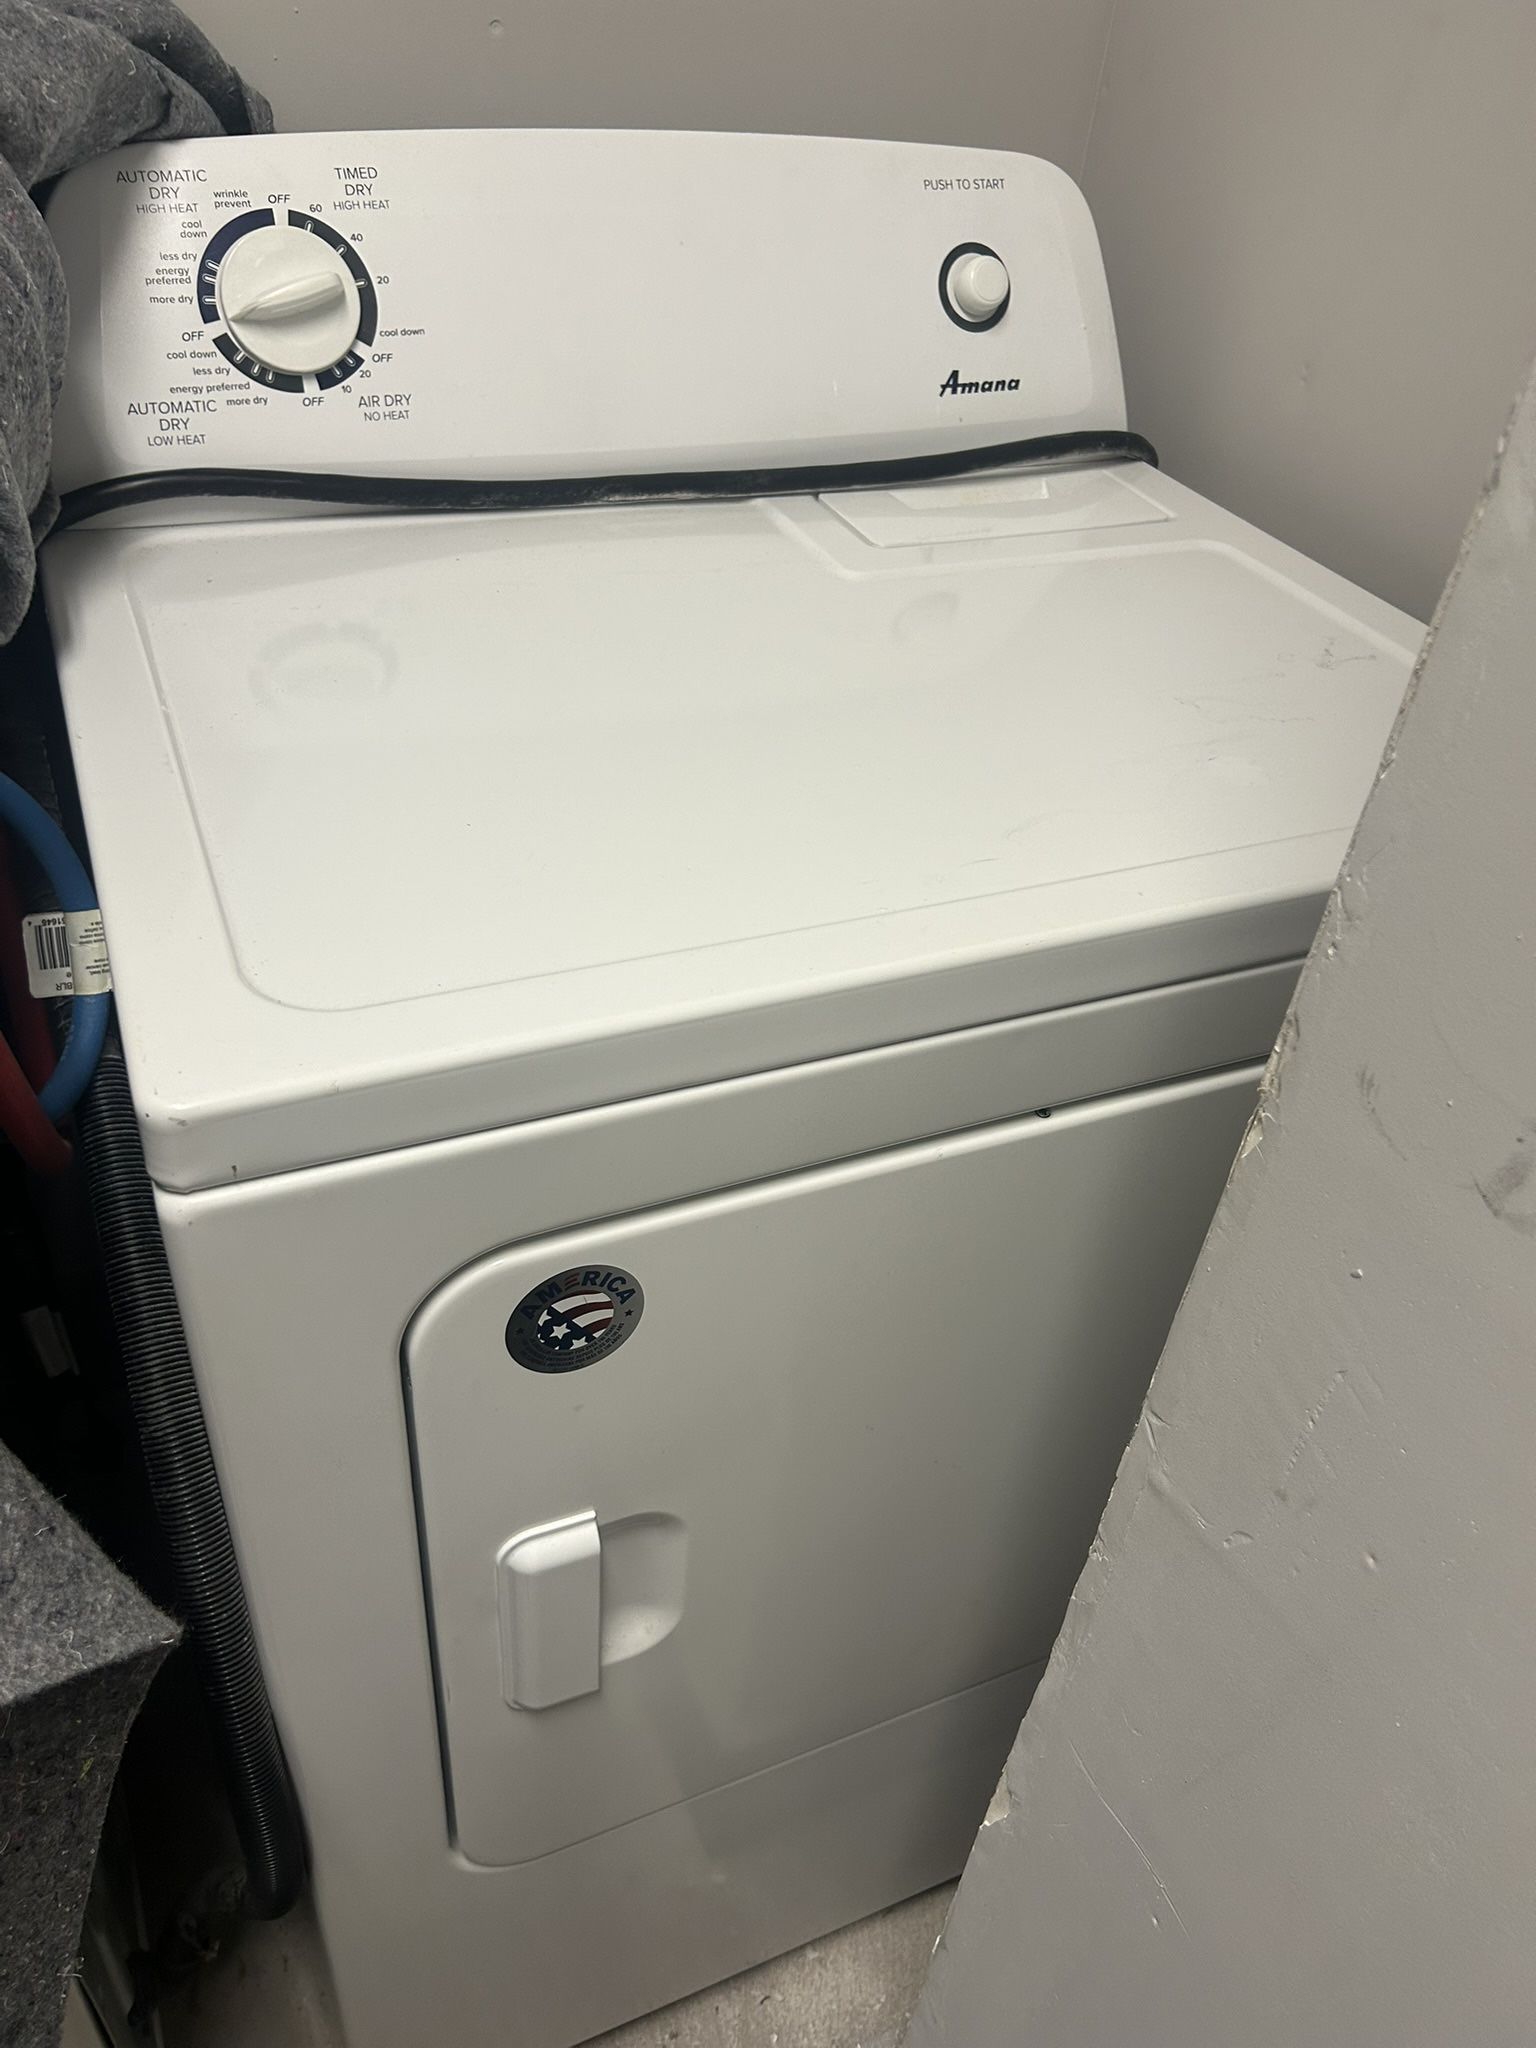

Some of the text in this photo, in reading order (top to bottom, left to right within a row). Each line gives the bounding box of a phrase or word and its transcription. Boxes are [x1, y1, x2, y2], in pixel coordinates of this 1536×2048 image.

[116, 169, 207, 183] AUTOMATIC
[334, 167, 378, 180] TIMED
[923, 178, 1005, 191] PUSH TO START
[149, 186, 180, 199] DRY
[213, 189, 248, 198] wrinkle
[345, 184, 373, 196] DRY
[268, 194, 291, 204] OFF
[136, 203, 198, 214] HIGH HEAT
[214, 200, 251, 209] prevent
[309, 204, 322, 213] 60
[334, 200, 390, 210] HIGH HEAT
[182, 220, 202, 228] cool
[180, 230, 207, 238] down
[350, 233, 363, 242] 40
[160, 251, 197, 261] less dry
[155, 268, 189, 276] energy
[145, 276, 192, 286] preferred
[377, 276, 389, 284] 20
[178, 295, 193, 304] dry
[182, 331, 204, 341] OFF
[380, 328, 425, 337] cool down
[167, 350, 217, 359] cool down
[372, 353, 393, 363] OFF
[193, 366, 231, 376] less dry
[359, 370, 371, 378] 20
[170, 382, 250, 395] energy preferred
[939, 370, 1020, 397] Amana
[341, 385, 352, 393] 10
[226, 396, 268, 406] more dry
[302, 397, 325, 407] OFF
[359, 394, 412, 408] AIR DRY
[128, 400, 217, 415] AUTOMATIC
[364, 410, 409, 421] NO HEAT
[160, 418, 190, 431] DRY
[148, 434, 206, 446] LOW HEAT
[519, 1270, 636, 1320] AMERICA
